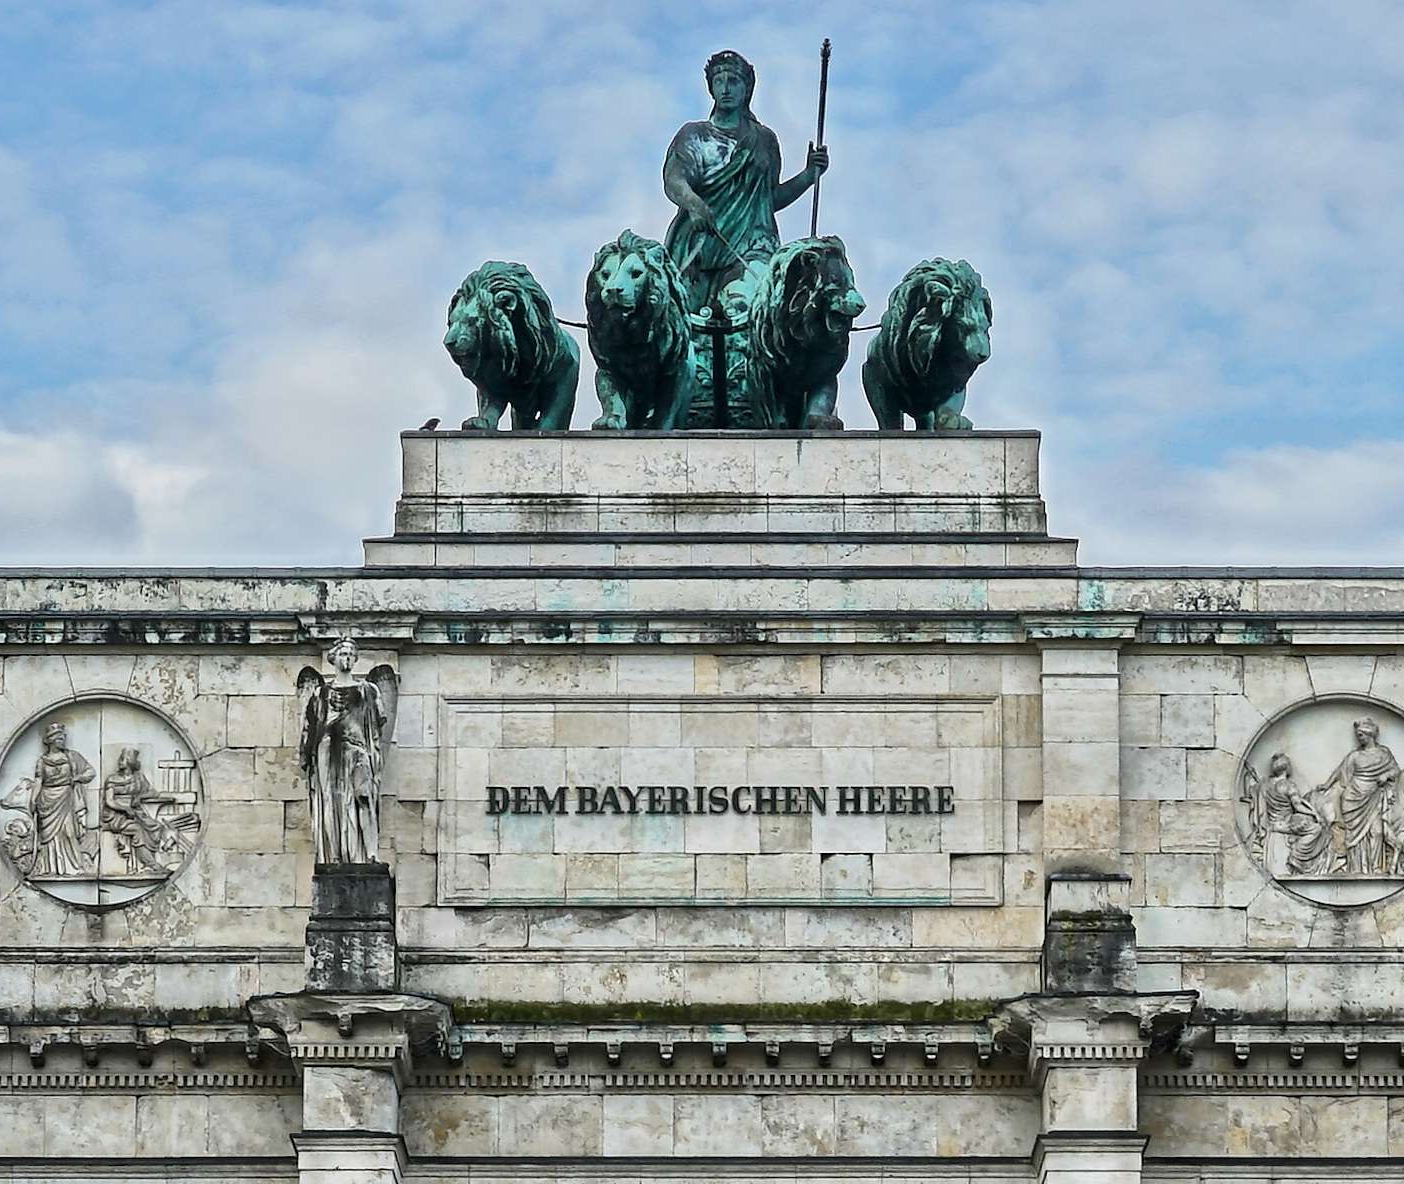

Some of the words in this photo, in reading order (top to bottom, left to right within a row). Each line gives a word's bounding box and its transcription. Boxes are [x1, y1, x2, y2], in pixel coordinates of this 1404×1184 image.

[485, 785, 569, 816] DEM
[574, 785, 829, 816] BAYERISCHEN
[835, 785, 955, 816] HEERE
